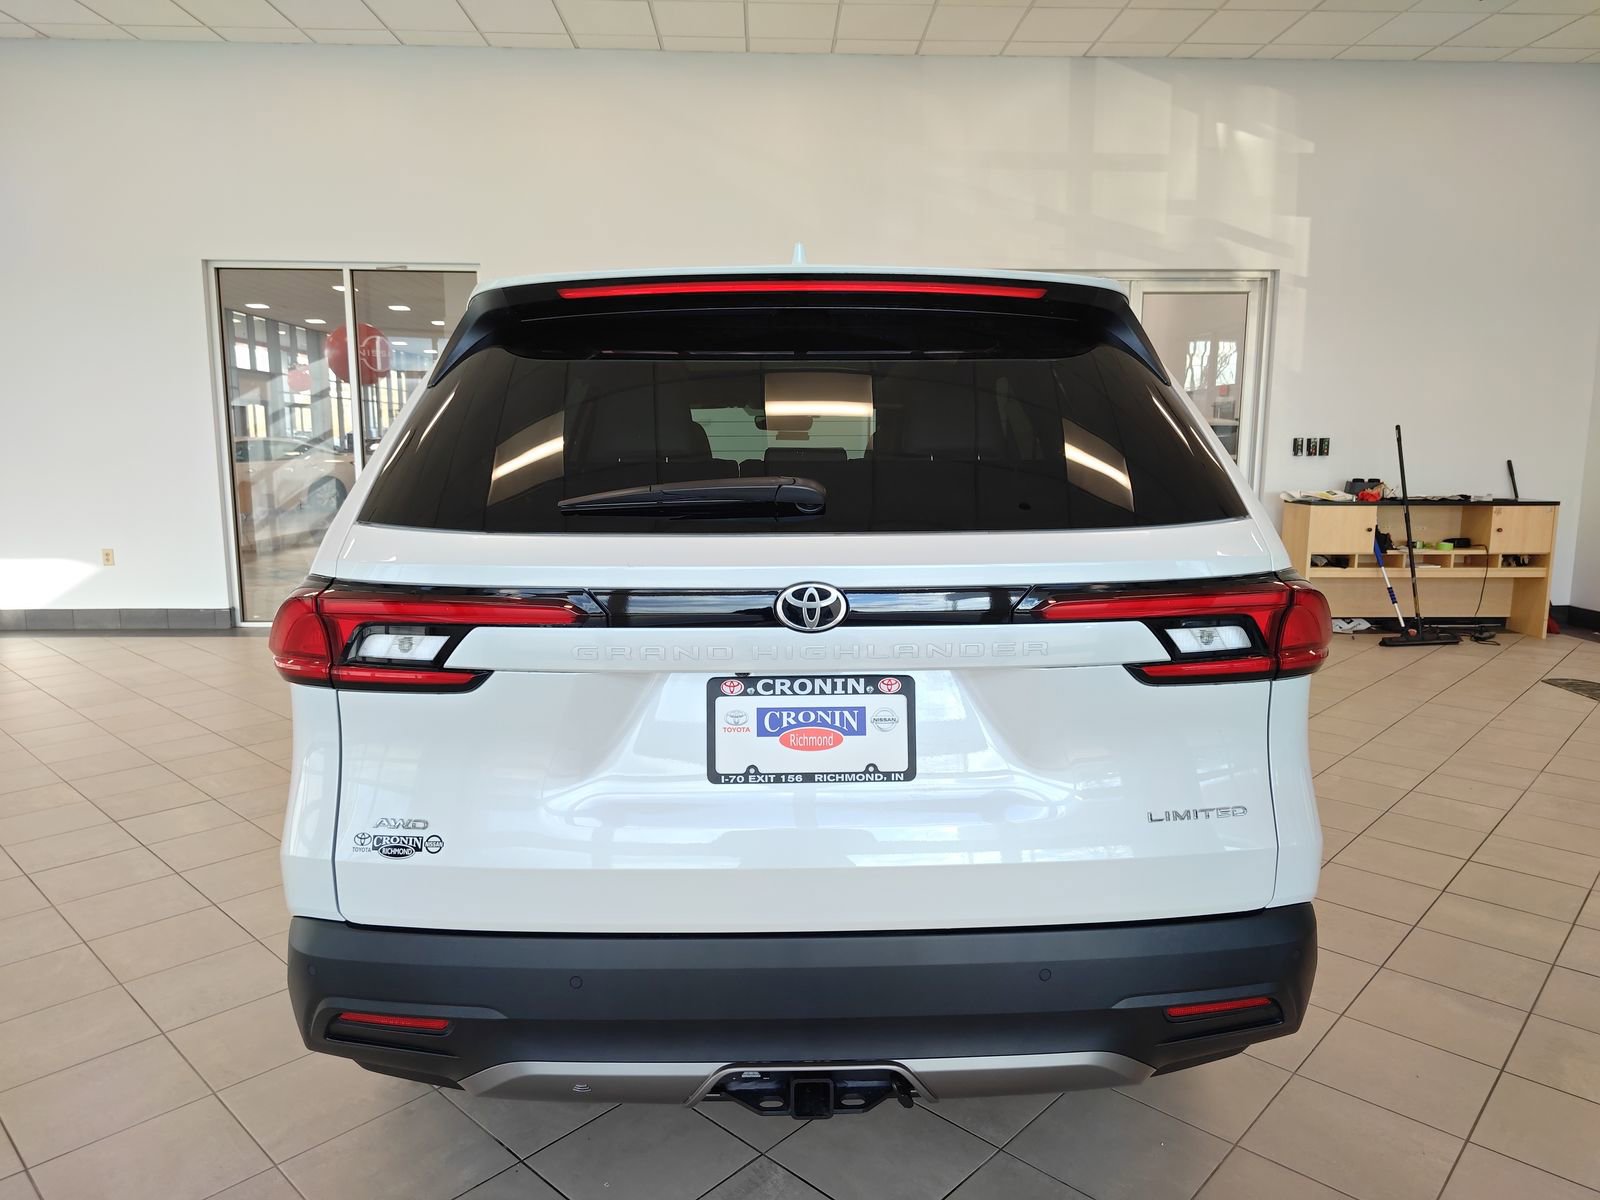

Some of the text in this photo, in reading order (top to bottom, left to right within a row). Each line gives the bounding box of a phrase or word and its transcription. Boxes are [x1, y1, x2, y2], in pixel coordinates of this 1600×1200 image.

[573, 641, 1048, 661] GRAND HIGHLANDER
[756, 678, 865, 695] CRONIN
[764, 710, 858, 732] CRONIN
[789, 733, 834, 747] Richmond
[721, 775, 745, 784] I-70
[749, 775, 776, 783] EXIT
[780, 775, 803, 783] 156
[891, 773, 904, 781] IN
[1147, 805, 1248, 823] LIMITED
[373, 817, 429, 830] AWD
[373, 835, 422, 849] CRONIN
[381, 847, 413, 855] RICHMOND
